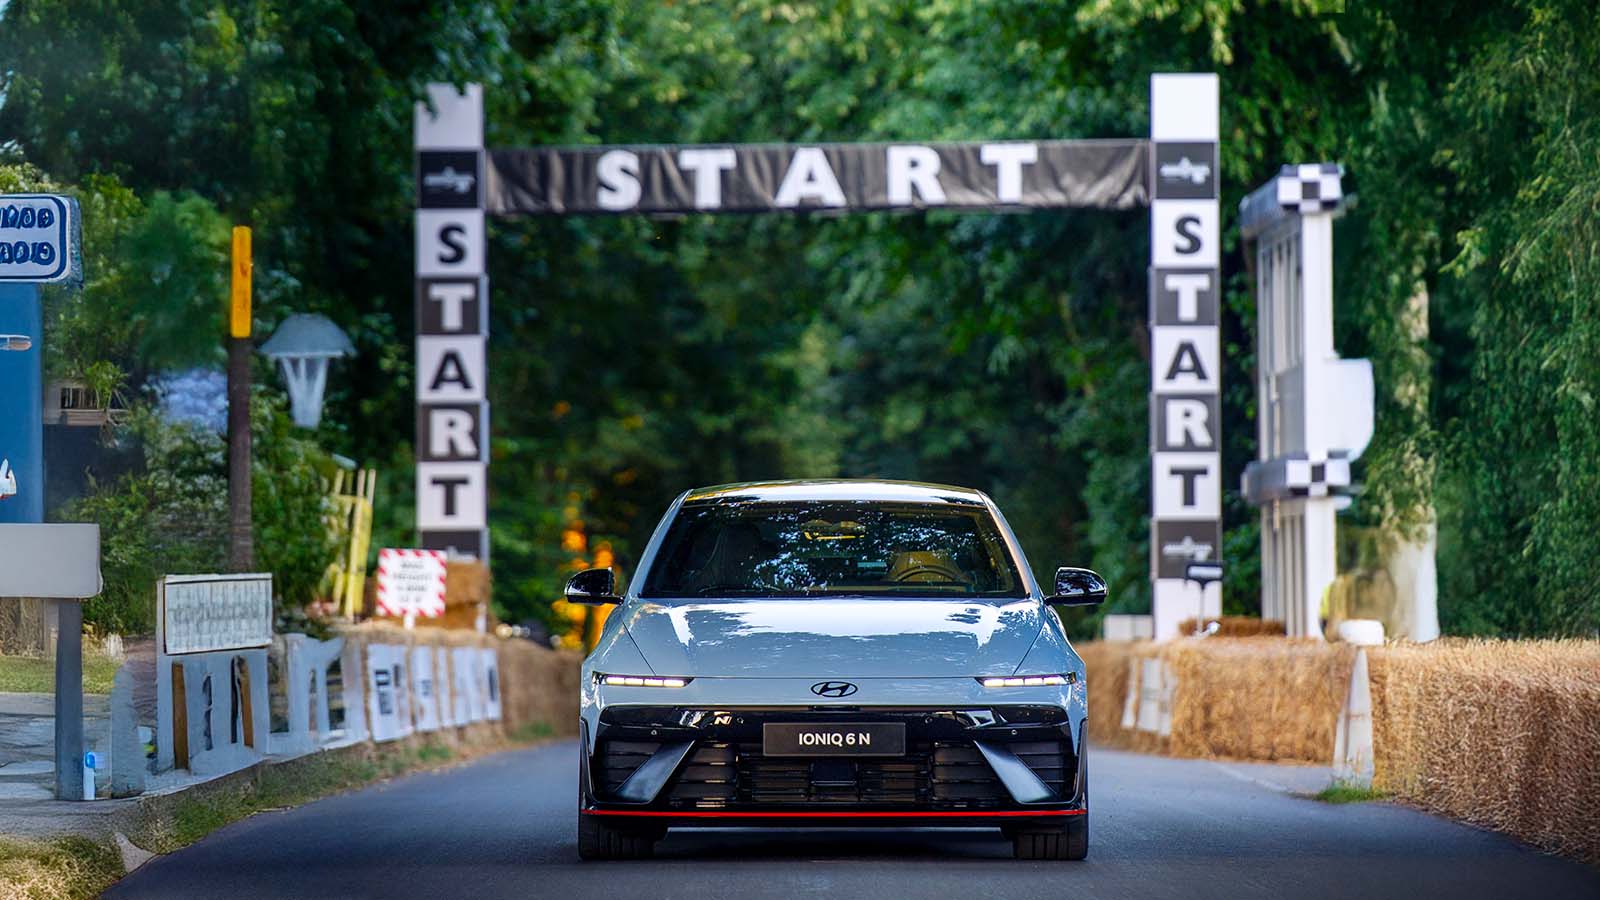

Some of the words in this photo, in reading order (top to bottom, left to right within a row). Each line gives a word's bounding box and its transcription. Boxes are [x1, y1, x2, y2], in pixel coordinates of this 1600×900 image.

[596, 143, 1038, 211] START
[428, 224, 477, 517] START
[1165, 216, 1212, 507] START
[798, 733, 843, 746] IONIQ
[846, 733, 855, 745] 6
[859, 733, 870, 745] N
